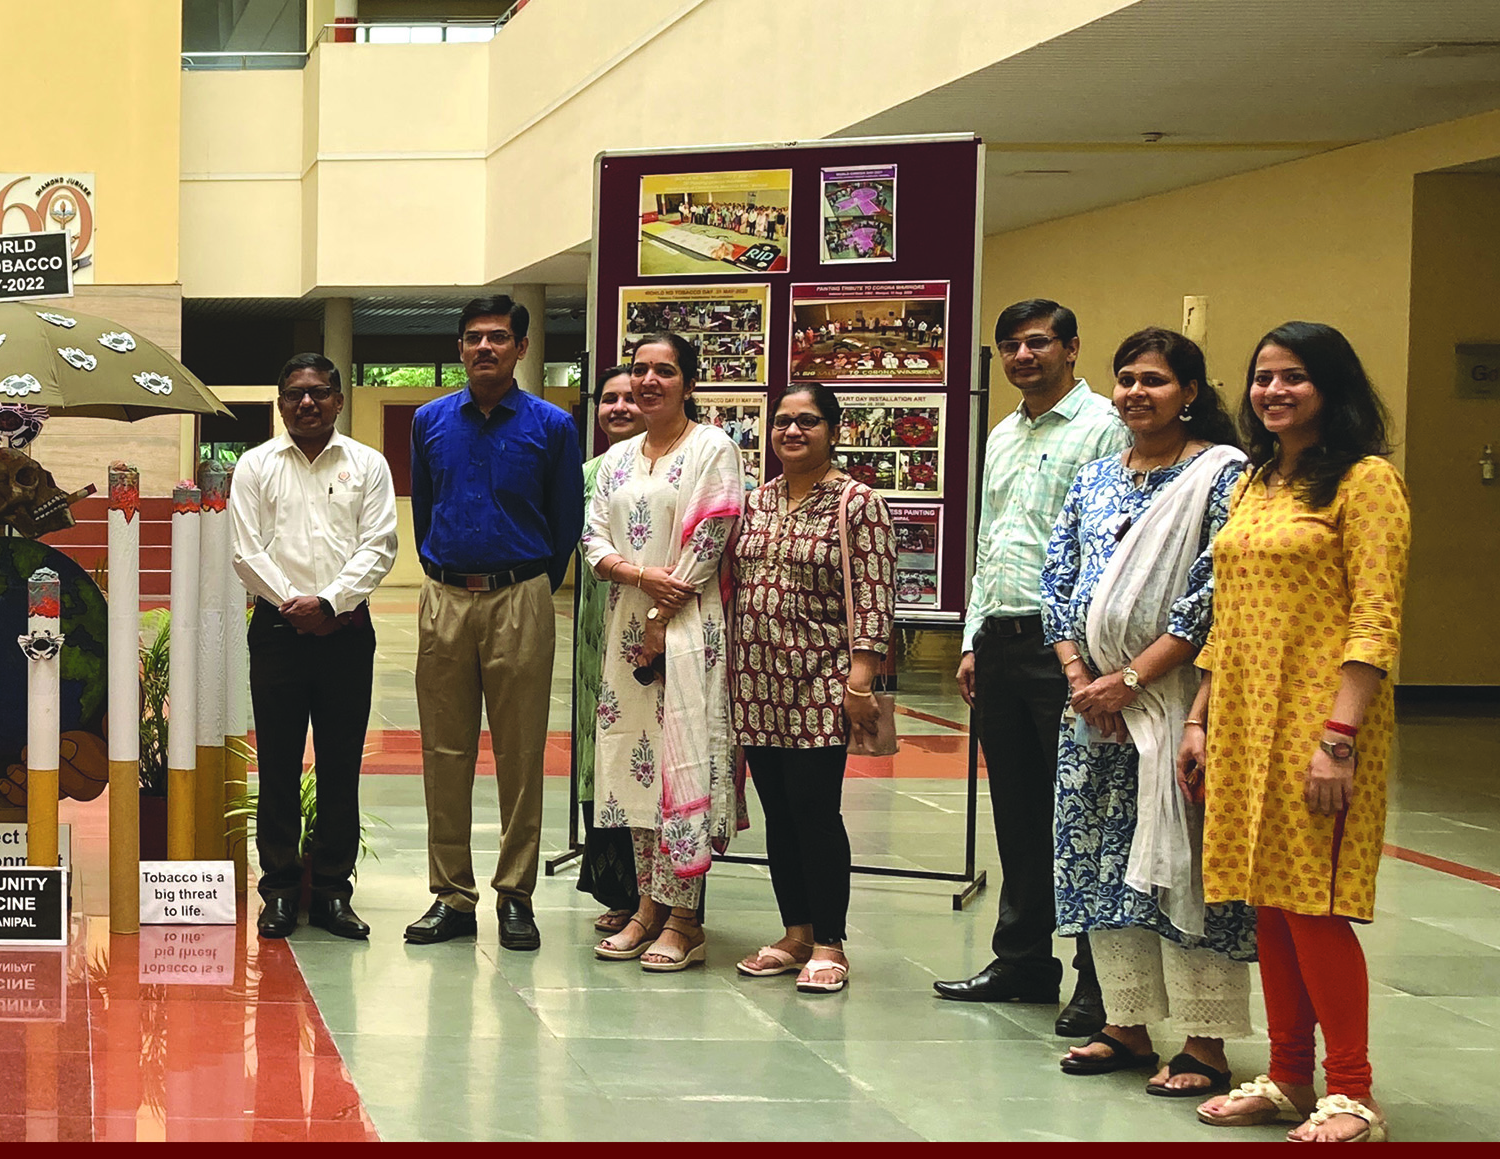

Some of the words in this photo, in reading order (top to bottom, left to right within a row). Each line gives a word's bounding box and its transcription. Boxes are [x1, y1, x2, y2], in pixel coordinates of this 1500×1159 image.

[35, 177, 64, 197] DIAMOND
[66, 177, 92, 197] JUBILEE
[745, 248, 775, 262] RIP
[143, 872, 198, 883] Tobacco
[202, 872, 213, 883] is
[217, 873, 225, 883] a
[155, 889, 175, 902] big
[179, 889, 218, 900] threat
[164, 906, 177, 917] to
[181, 905, 205, 917] life.
